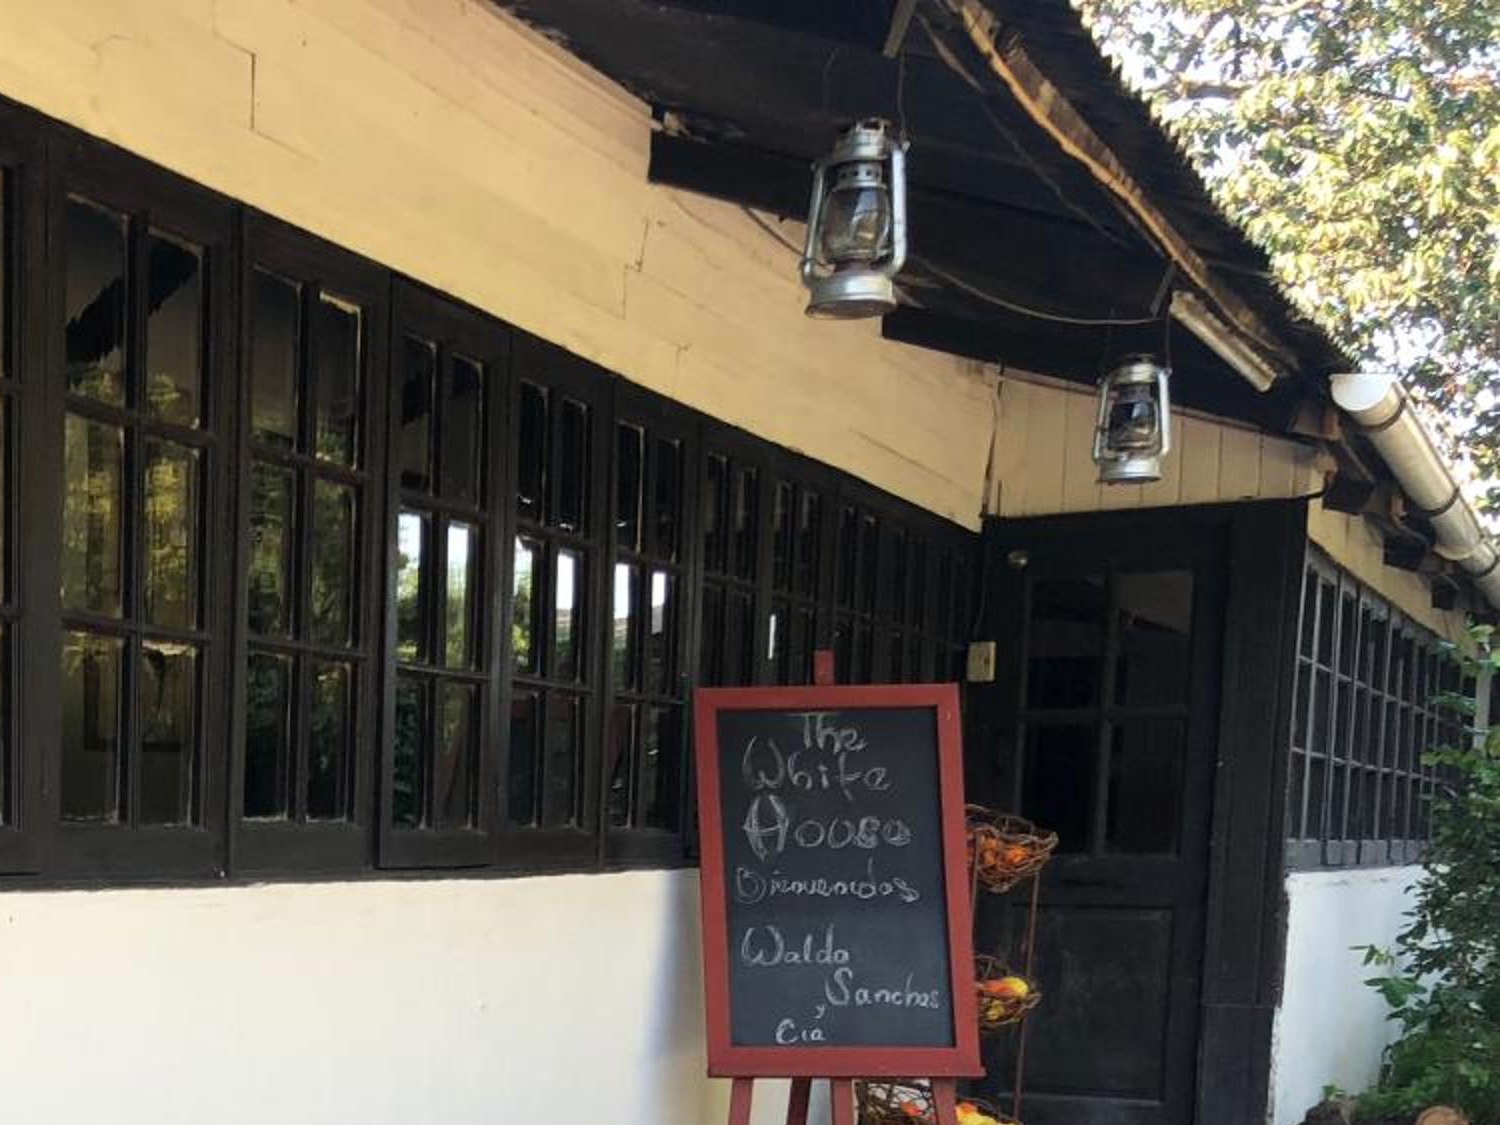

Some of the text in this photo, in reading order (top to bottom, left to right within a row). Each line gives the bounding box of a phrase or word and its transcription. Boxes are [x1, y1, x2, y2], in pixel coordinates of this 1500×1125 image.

[787, 711, 867, 754] The
[741, 736, 892, 801] White
[741, 922, 850, 966] Waldo
